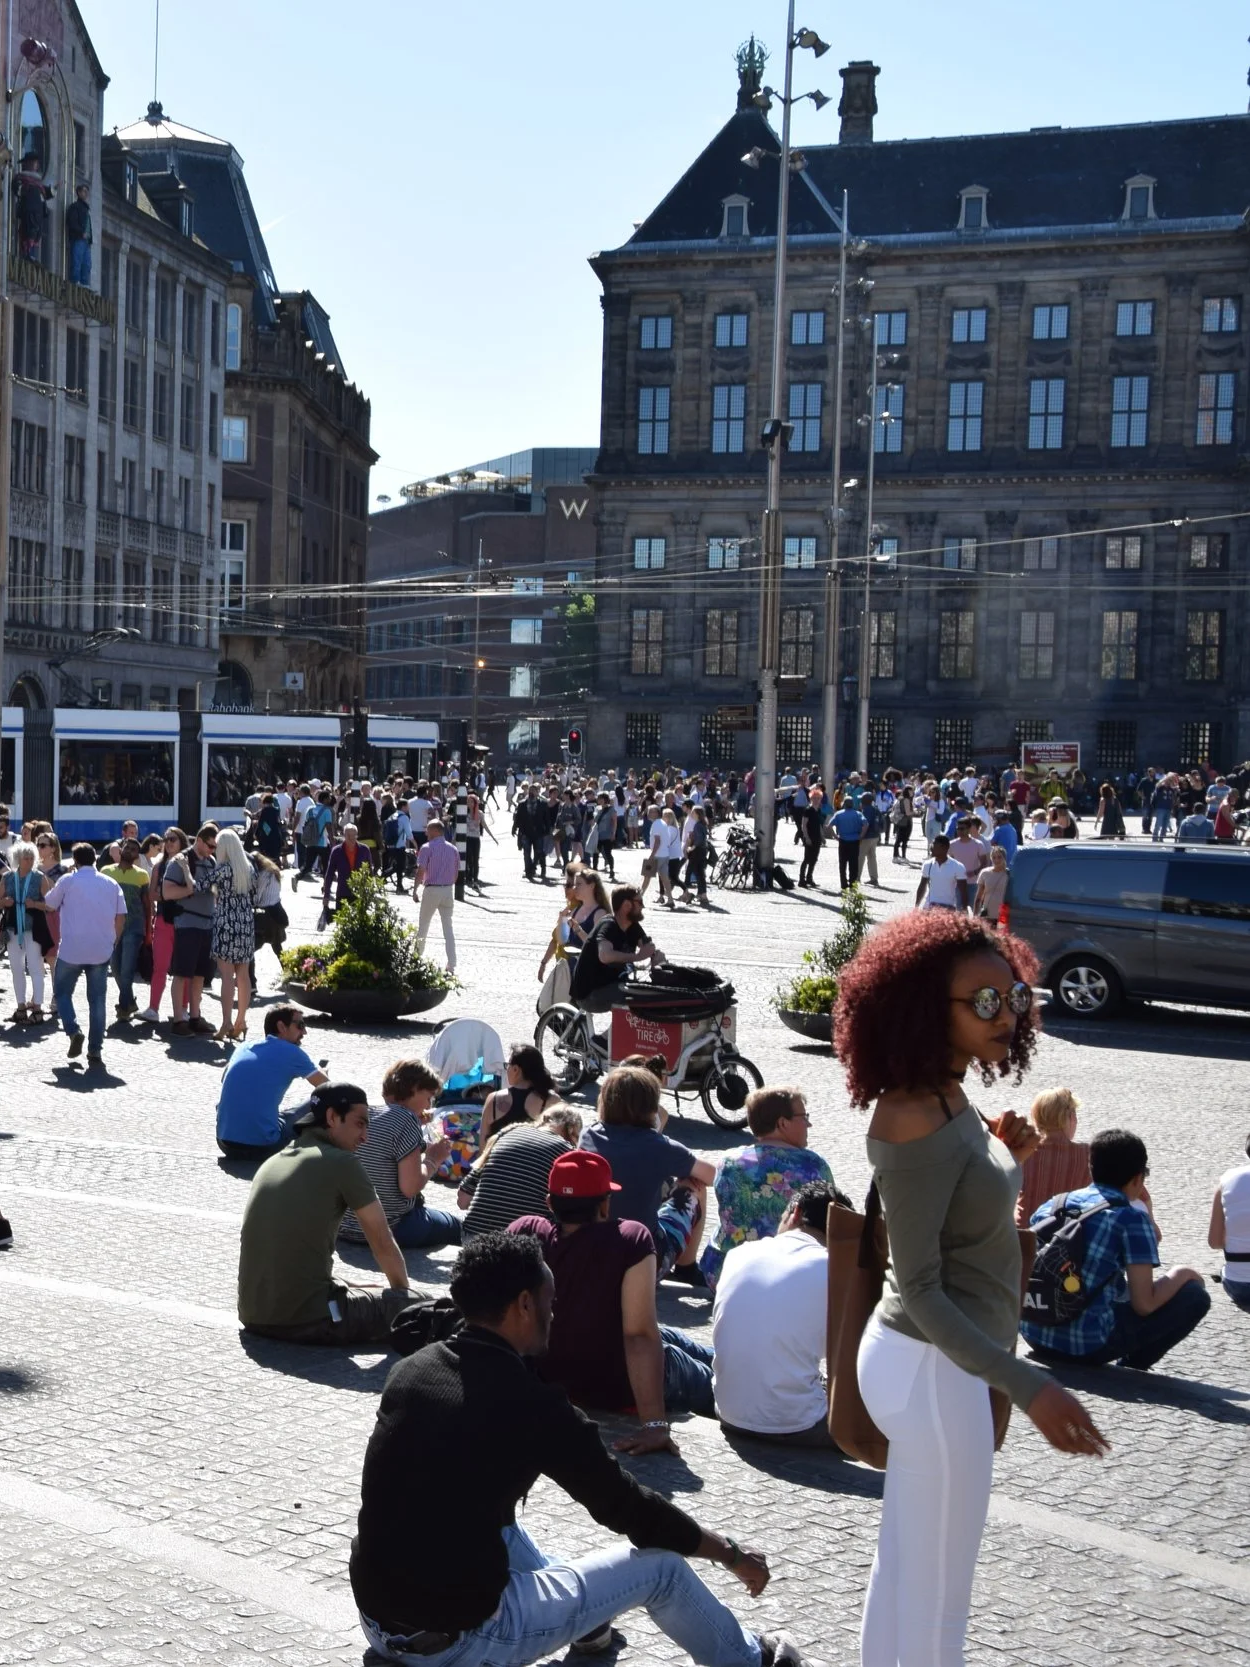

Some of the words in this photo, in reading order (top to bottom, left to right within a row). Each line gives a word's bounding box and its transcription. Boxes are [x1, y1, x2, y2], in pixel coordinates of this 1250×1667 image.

[559, 498, 589, 520] W
[209, 702, 255, 713] Rabobank
[636, 1028, 654, 1042] TIRE
